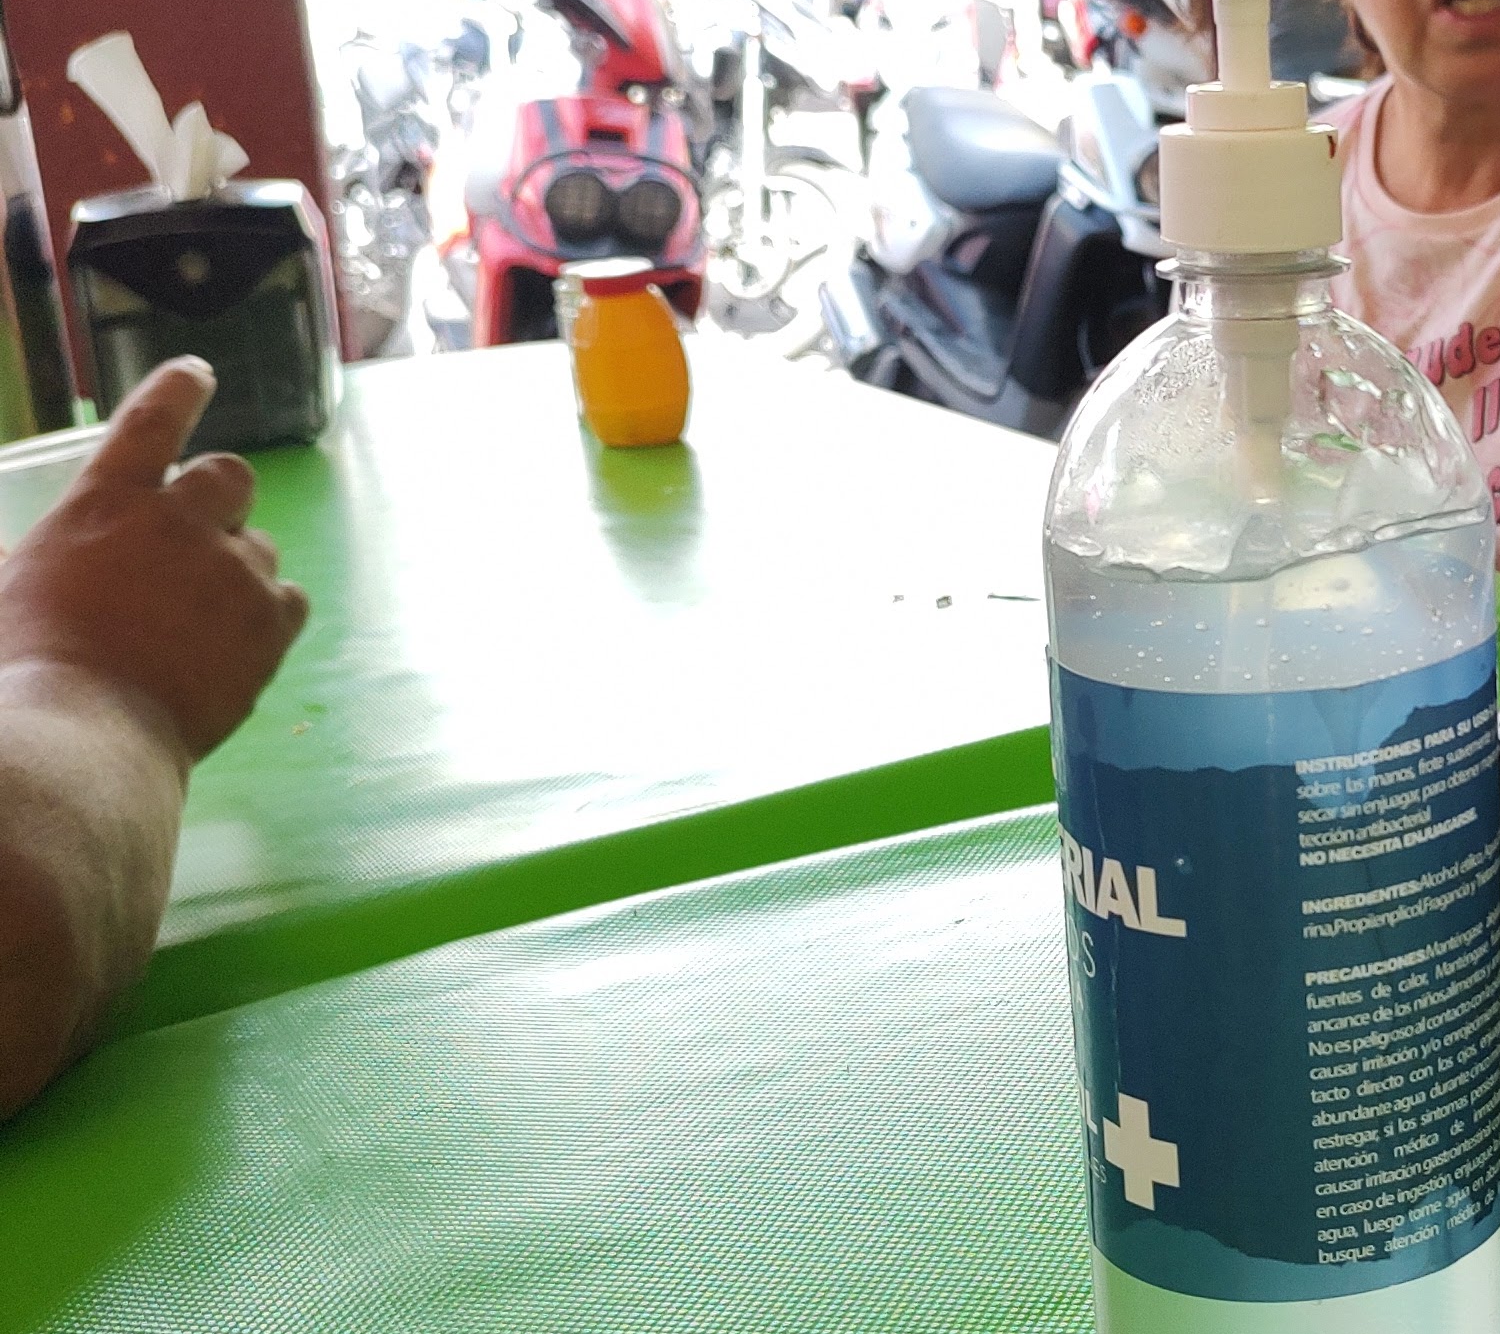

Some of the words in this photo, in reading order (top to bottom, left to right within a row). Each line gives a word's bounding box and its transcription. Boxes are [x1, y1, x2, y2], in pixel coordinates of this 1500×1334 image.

[1295, 738, 1422, 776] INSTRUCCIONES
[1423, 726, 1456, 750] PARA
[1456, 718, 1471, 737] SU
[1296, 780, 1341, 800] sobre
[1345, 776, 1365, 794] las
[1418, 756, 1445, 776] frote
[1298, 806, 1337, 824] secar
[1339, 803, 1363, 819] sin
[1421, 779, 1447, 803] para
[1299, 826, 1354, 848] tección
[1300, 850, 1327, 866] NO
[1328, 836, 1402, 864] NECESITA
[1306, 990, 1363, 1011] fuentes
[1370, 981, 1393, 1000] de
[1372, 1004, 1394, 1023] de
[1394, 1001, 1412, 1017] los
[1308, 1040, 1333, 1057] No
[1333, 1038, 1352, 1054] es
[1352, 1024, 1414, 1055] peligroso
[1413, 1016, 1426, 1035] al
[1309, 1061, 1358, 1081] causar
[1361, 1045, 1418, 1073] irritación
[1420, 1036, 1442, 1060] y/o
[1310, 1085, 1350, 1104] tacto
[1355, 1074, 1405, 1097] directo
[1408, 1065, 1434, 1083] con
[1437, 1056, 1455, 1073] los
[1311, 1101, 1392, 1127] abundante
[1392, 1090, 1427, 1113] agua
[1429, 1070, 1470, 1100] durante
[1313, 1129, 1380, 1150] restregar,
[1383, 1121, 1395, 1138] si
[1397, 1116, 1418, 1133] los
[1313, 1150, 1379, 1174] atención
[1393, 1131, 1440, 1158] médica
[1449, 1118, 1466, 1136] de
[1315, 1178, 1364, 1197] causar
[1364, 1161, 1422, 1189] irritación
[1316, 1205, 1337, 1219] en
[1339, 1199, 1374, 1216] caso
[1374, 1190, 1396, 1209] de
[1317, 1225, 1359, 1245] agua,
[1363, 1214, 1405, 1235] luego
[1408, 1200, 1442, 1223] tome
[1444, 1185, 1470, 1209] agua
[1472, 1176, 1485, 1193] en
[1318, 1243, 1376, 1265] busque
[1384, 1223, 1440, 1253] atención
[1446, 1201, 1481, 1230] médica
[1484, 1188, 1495, 1206] de
